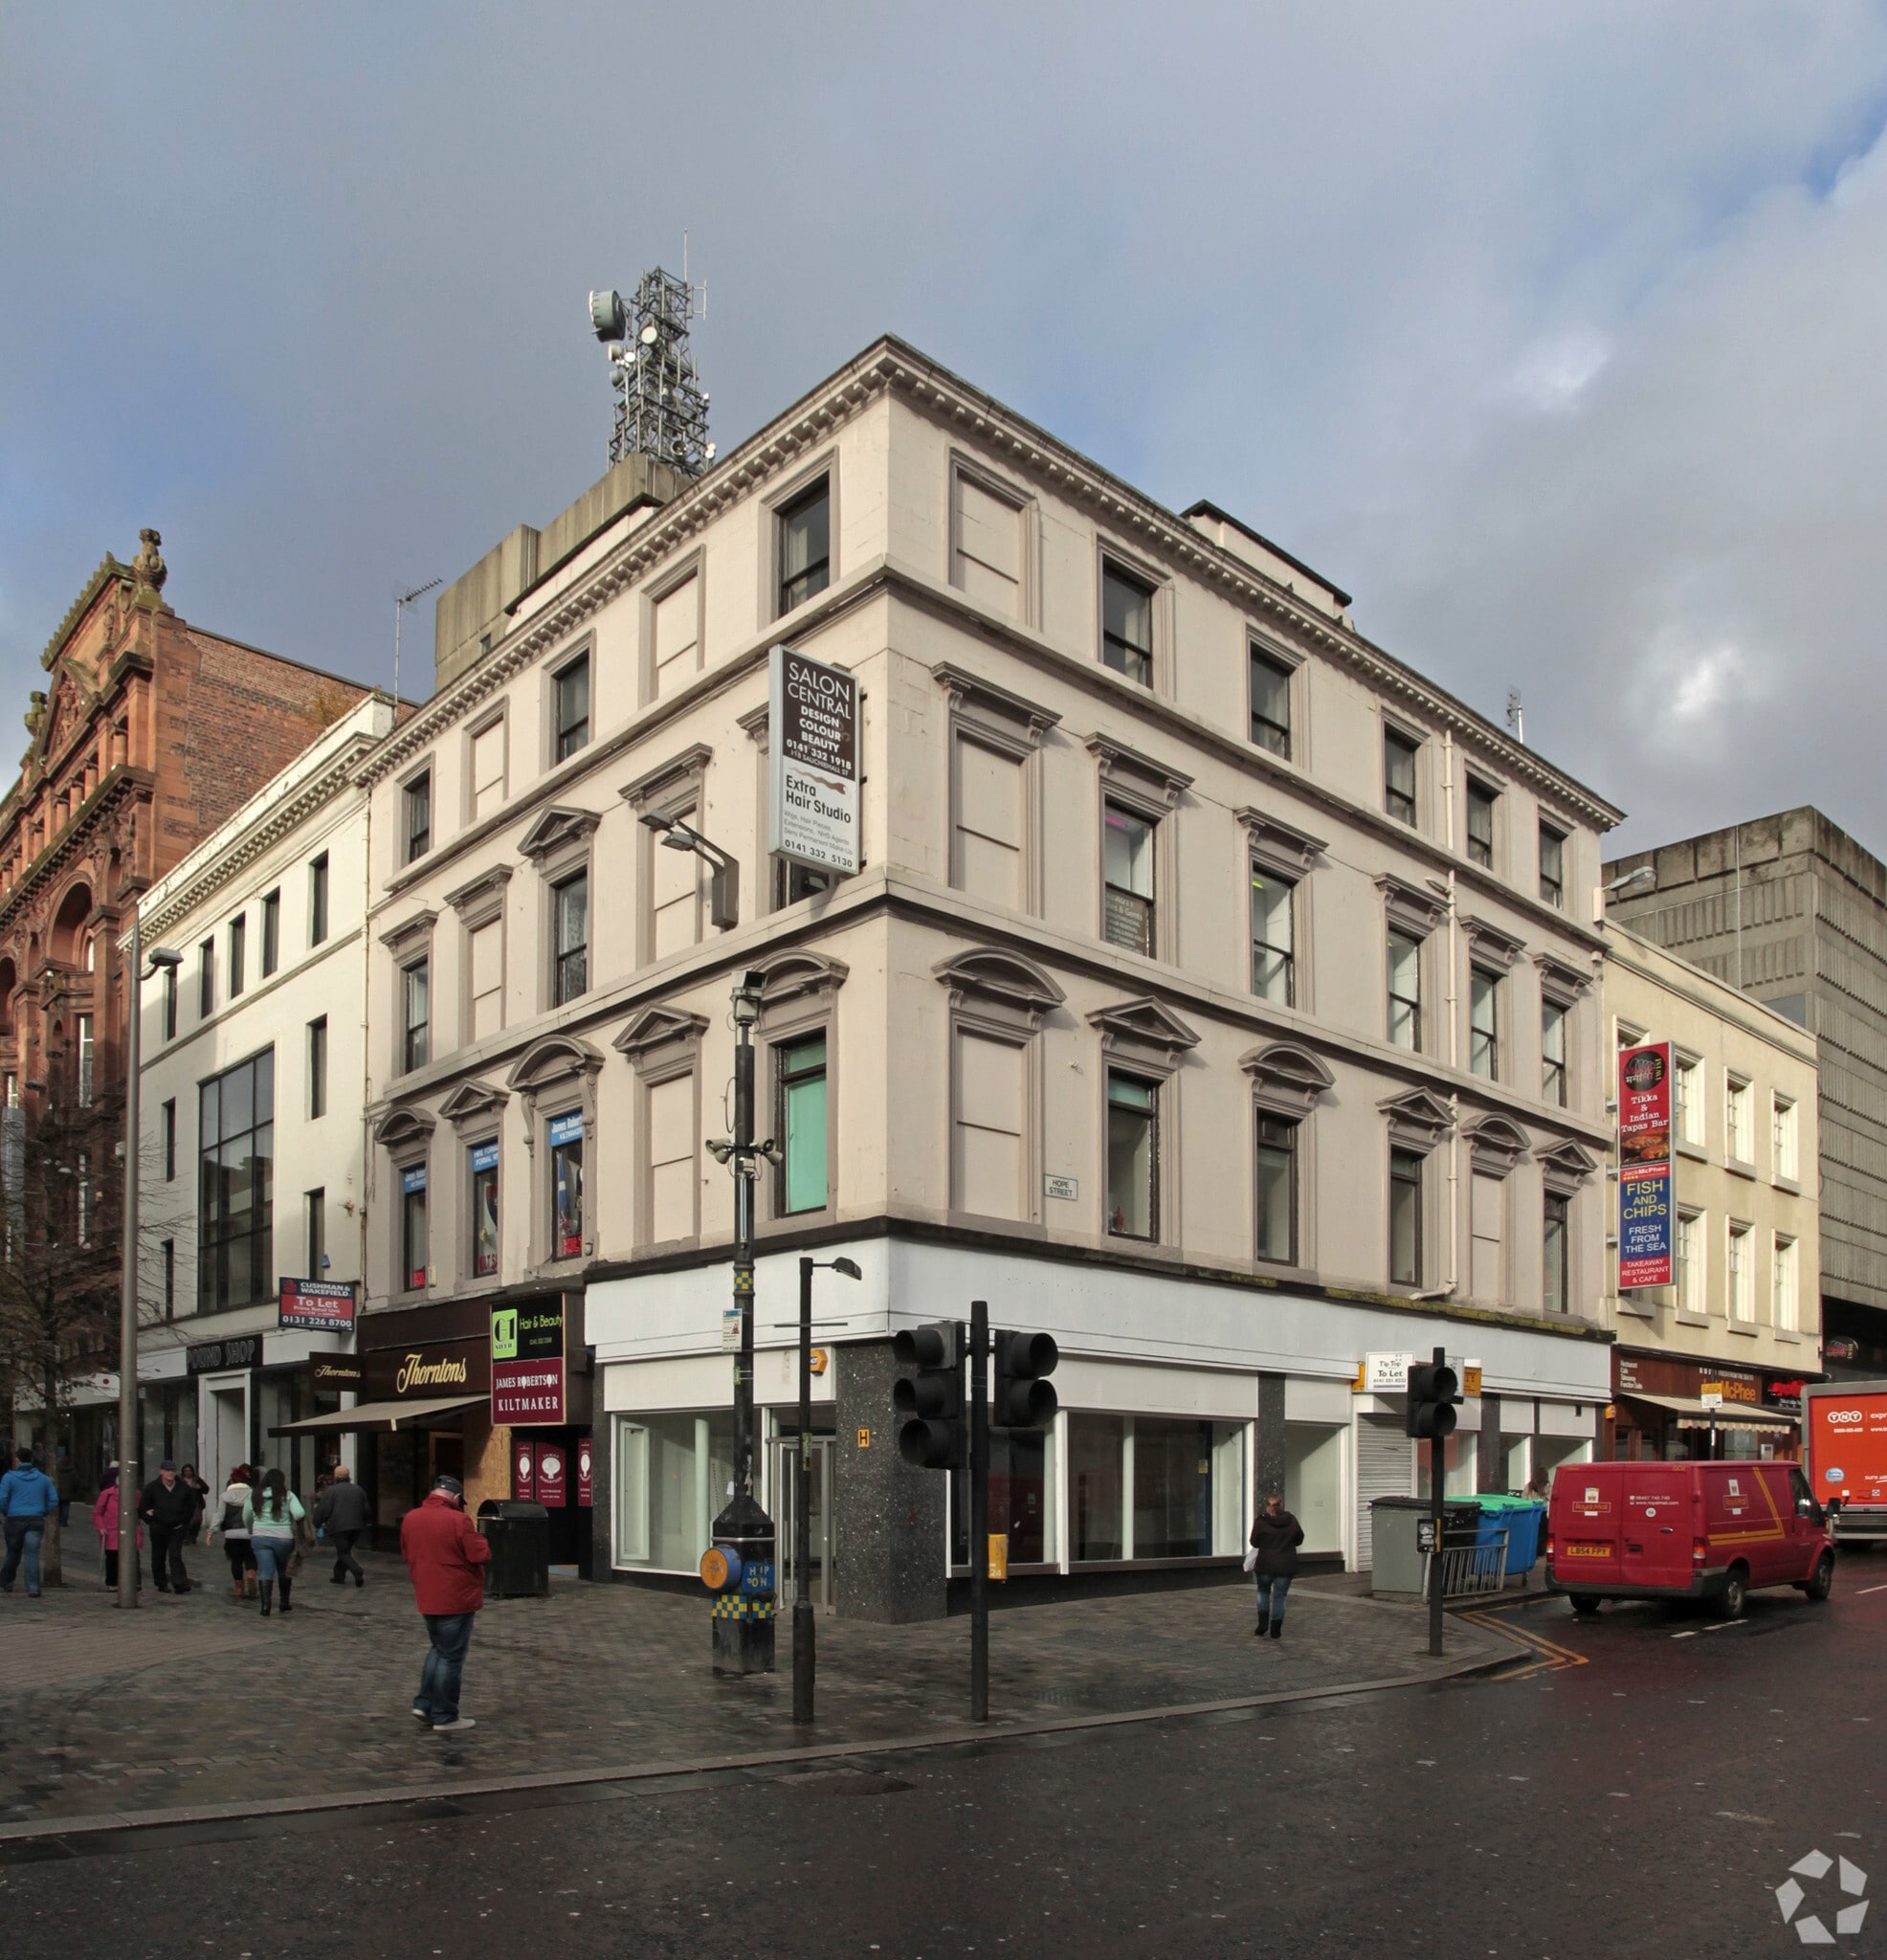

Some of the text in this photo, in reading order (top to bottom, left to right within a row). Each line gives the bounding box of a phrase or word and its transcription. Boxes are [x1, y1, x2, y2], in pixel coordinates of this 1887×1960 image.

[788, 662, 849, 702] SALON
[788, 682, 851, 720] CENTRAL
[801, 705, 840, 728] DESIGN
[799, 718, 841, 741] COLOUR
[801, 731, 840, 753] BEAUTY
[787, 739, 852, 770] 0141 332 1918
[786, 774, 816, 796] Extra
[786, 790, 851, 824] Hair Studio
[785, 839, 853, 868] 0141 332 5130
[1631, 1094, 1658, 1104] Tikka
[1630, 1112, 1660, 1123] Indian
[1621, 1119, 1668, 1133] Tapas Bar
[1049, 1186, 1072, 1196] STREET
[1627, 1179, 1663, 1196] FISH
[1633, 1194, 1657, 1205] AND
[1623, 1203, 1667, 1219] CHIPS
[1629, 1224, 1662, 1235] FRESH
[1631, 1234, 1659, 1244] FROM
[1625, 1242, 1666, 1253] THE SEA
[1627, 1258, 1664, 1268] TAKEAWAY
[1622, 1266, 1669, 1277] RESTAURANT
[300, 1282, 344, 1291] CUSHMAN
[300, 1288, 349, 1296] WAKEFIELD
[297, 1296, 338, 1308] To Let
[283, 1315, 305, 1324] 0131
[309, 1317, 326, 1325] 226
[329, 1318, 352, 1327] 8700
[520, 1314, 563, 1330] Hair & Beauty
[225, 1340, 255, 1366] SHOP
[315, 1364, 361, 1378] Thorntons
[397, 1353, 466, 1393] Thorntons
[496, 1374, 558, 1390] JAMES ROBERTSON
[498, 1396, 558, 1411] KILTMAKER
[1828, 1411, 1862, 1423] TNT
[860, 1431, 868, 1445] H
